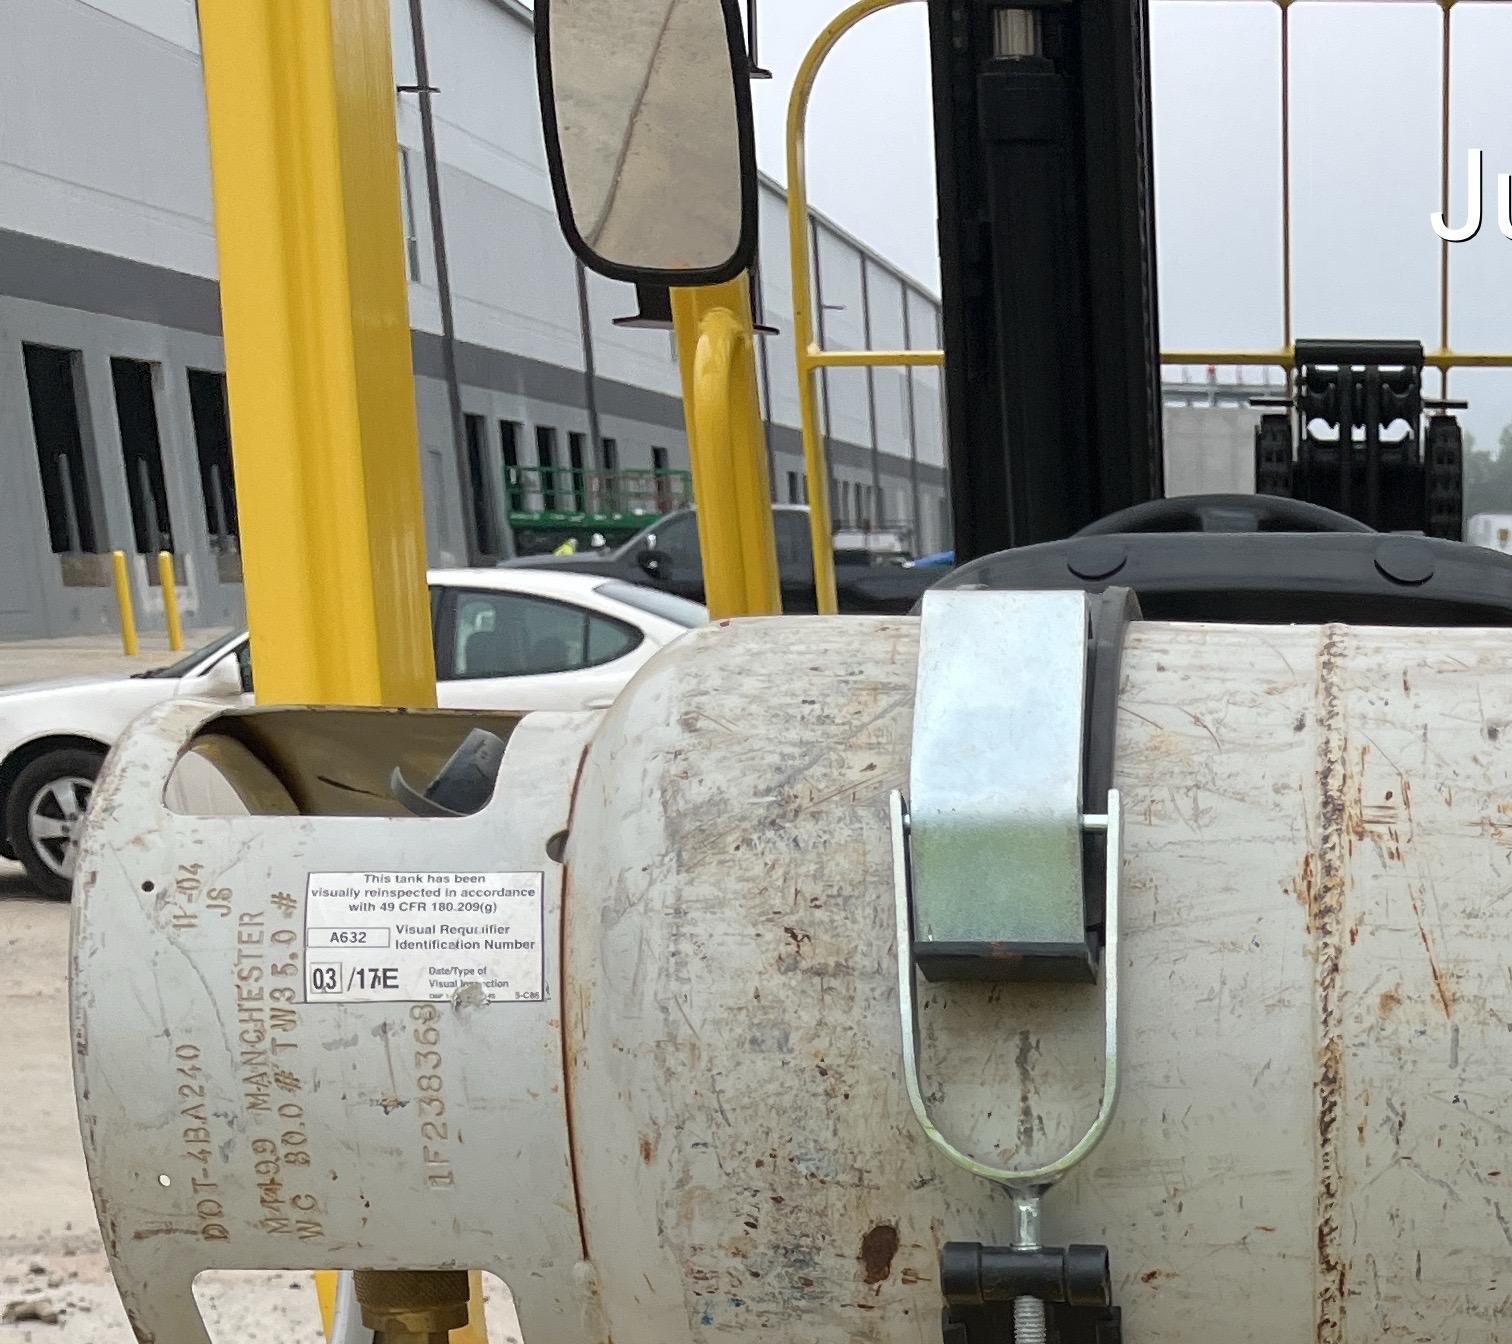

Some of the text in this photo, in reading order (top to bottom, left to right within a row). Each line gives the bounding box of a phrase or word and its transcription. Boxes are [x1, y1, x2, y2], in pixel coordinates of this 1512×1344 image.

[364, 874, 486, 884] This tank has been
[311, 888, 536, 898] visually reinspected in accordance
[349, 902, 497, 914] with 49 CFR 180.209(g)
[396, 924, 436, 935] Visual
[329, 931, 367, 944] A632
[395, 939, 536, 950] Identification Number
[429, 966, 475, 977] Date/Type
[313, 968, 336, 990] 03
[429, 979, 457, 988] Visual
